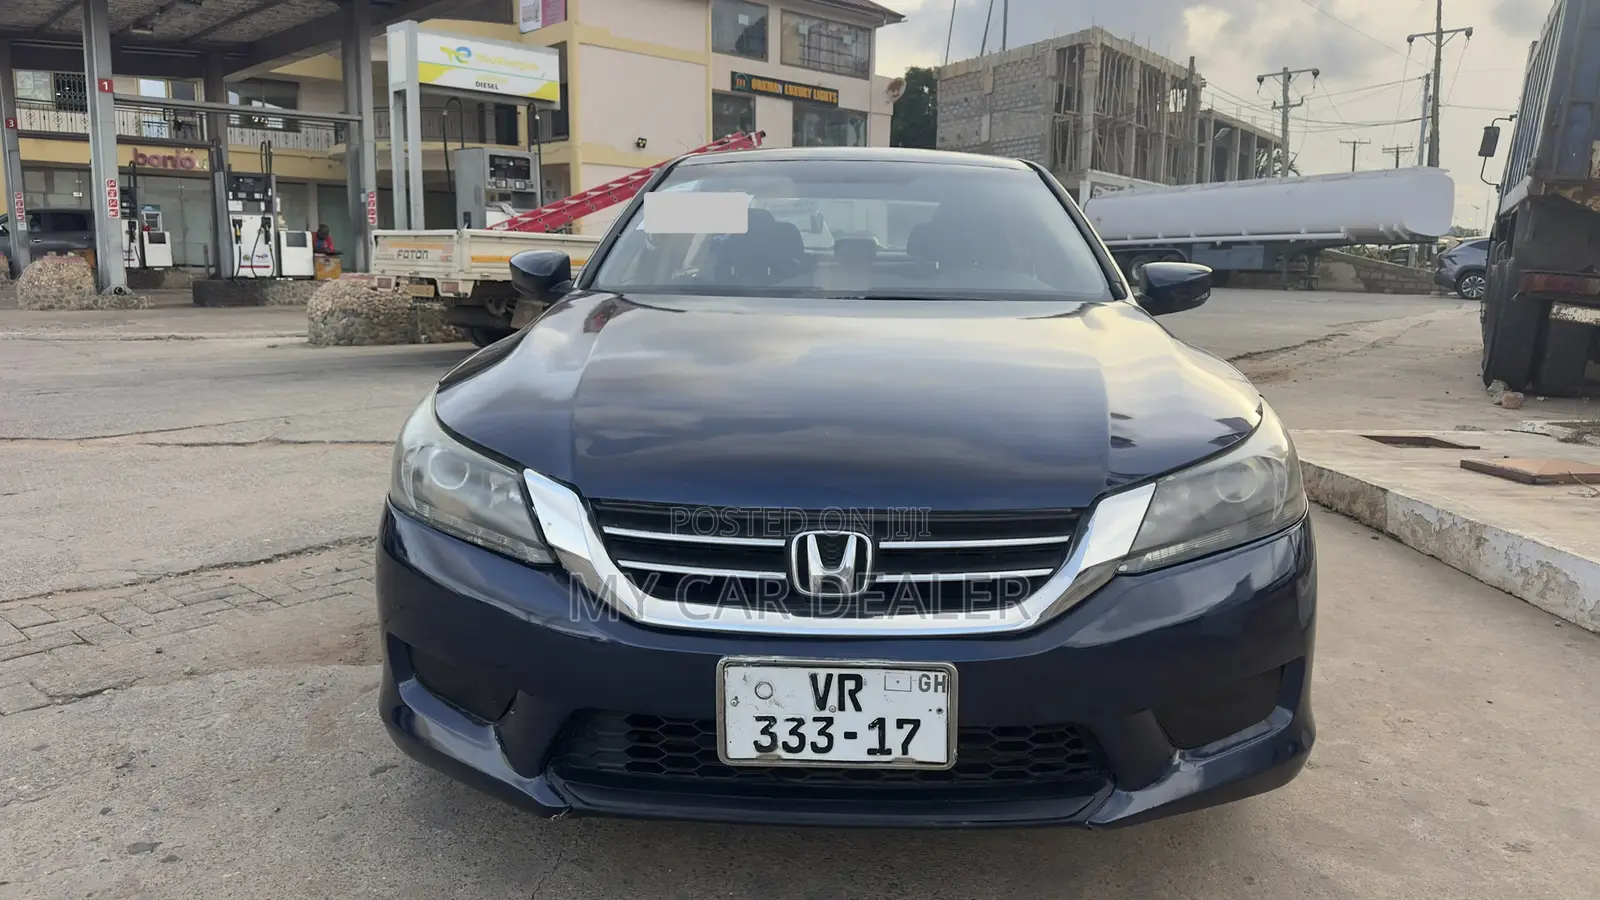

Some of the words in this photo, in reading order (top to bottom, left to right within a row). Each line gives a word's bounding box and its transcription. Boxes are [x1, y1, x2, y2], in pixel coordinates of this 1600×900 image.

[103, 81, 108, 90] 1
[475, 81, 499, 90] DIESEL
[812, 88, 838, 104] LIGHTS
[397, 249, 429, 260] FOTON
[918, 673, 946, 693] GH
[808, 673, 863, 712] VR
[753, 715, 921, 756] 333-17
